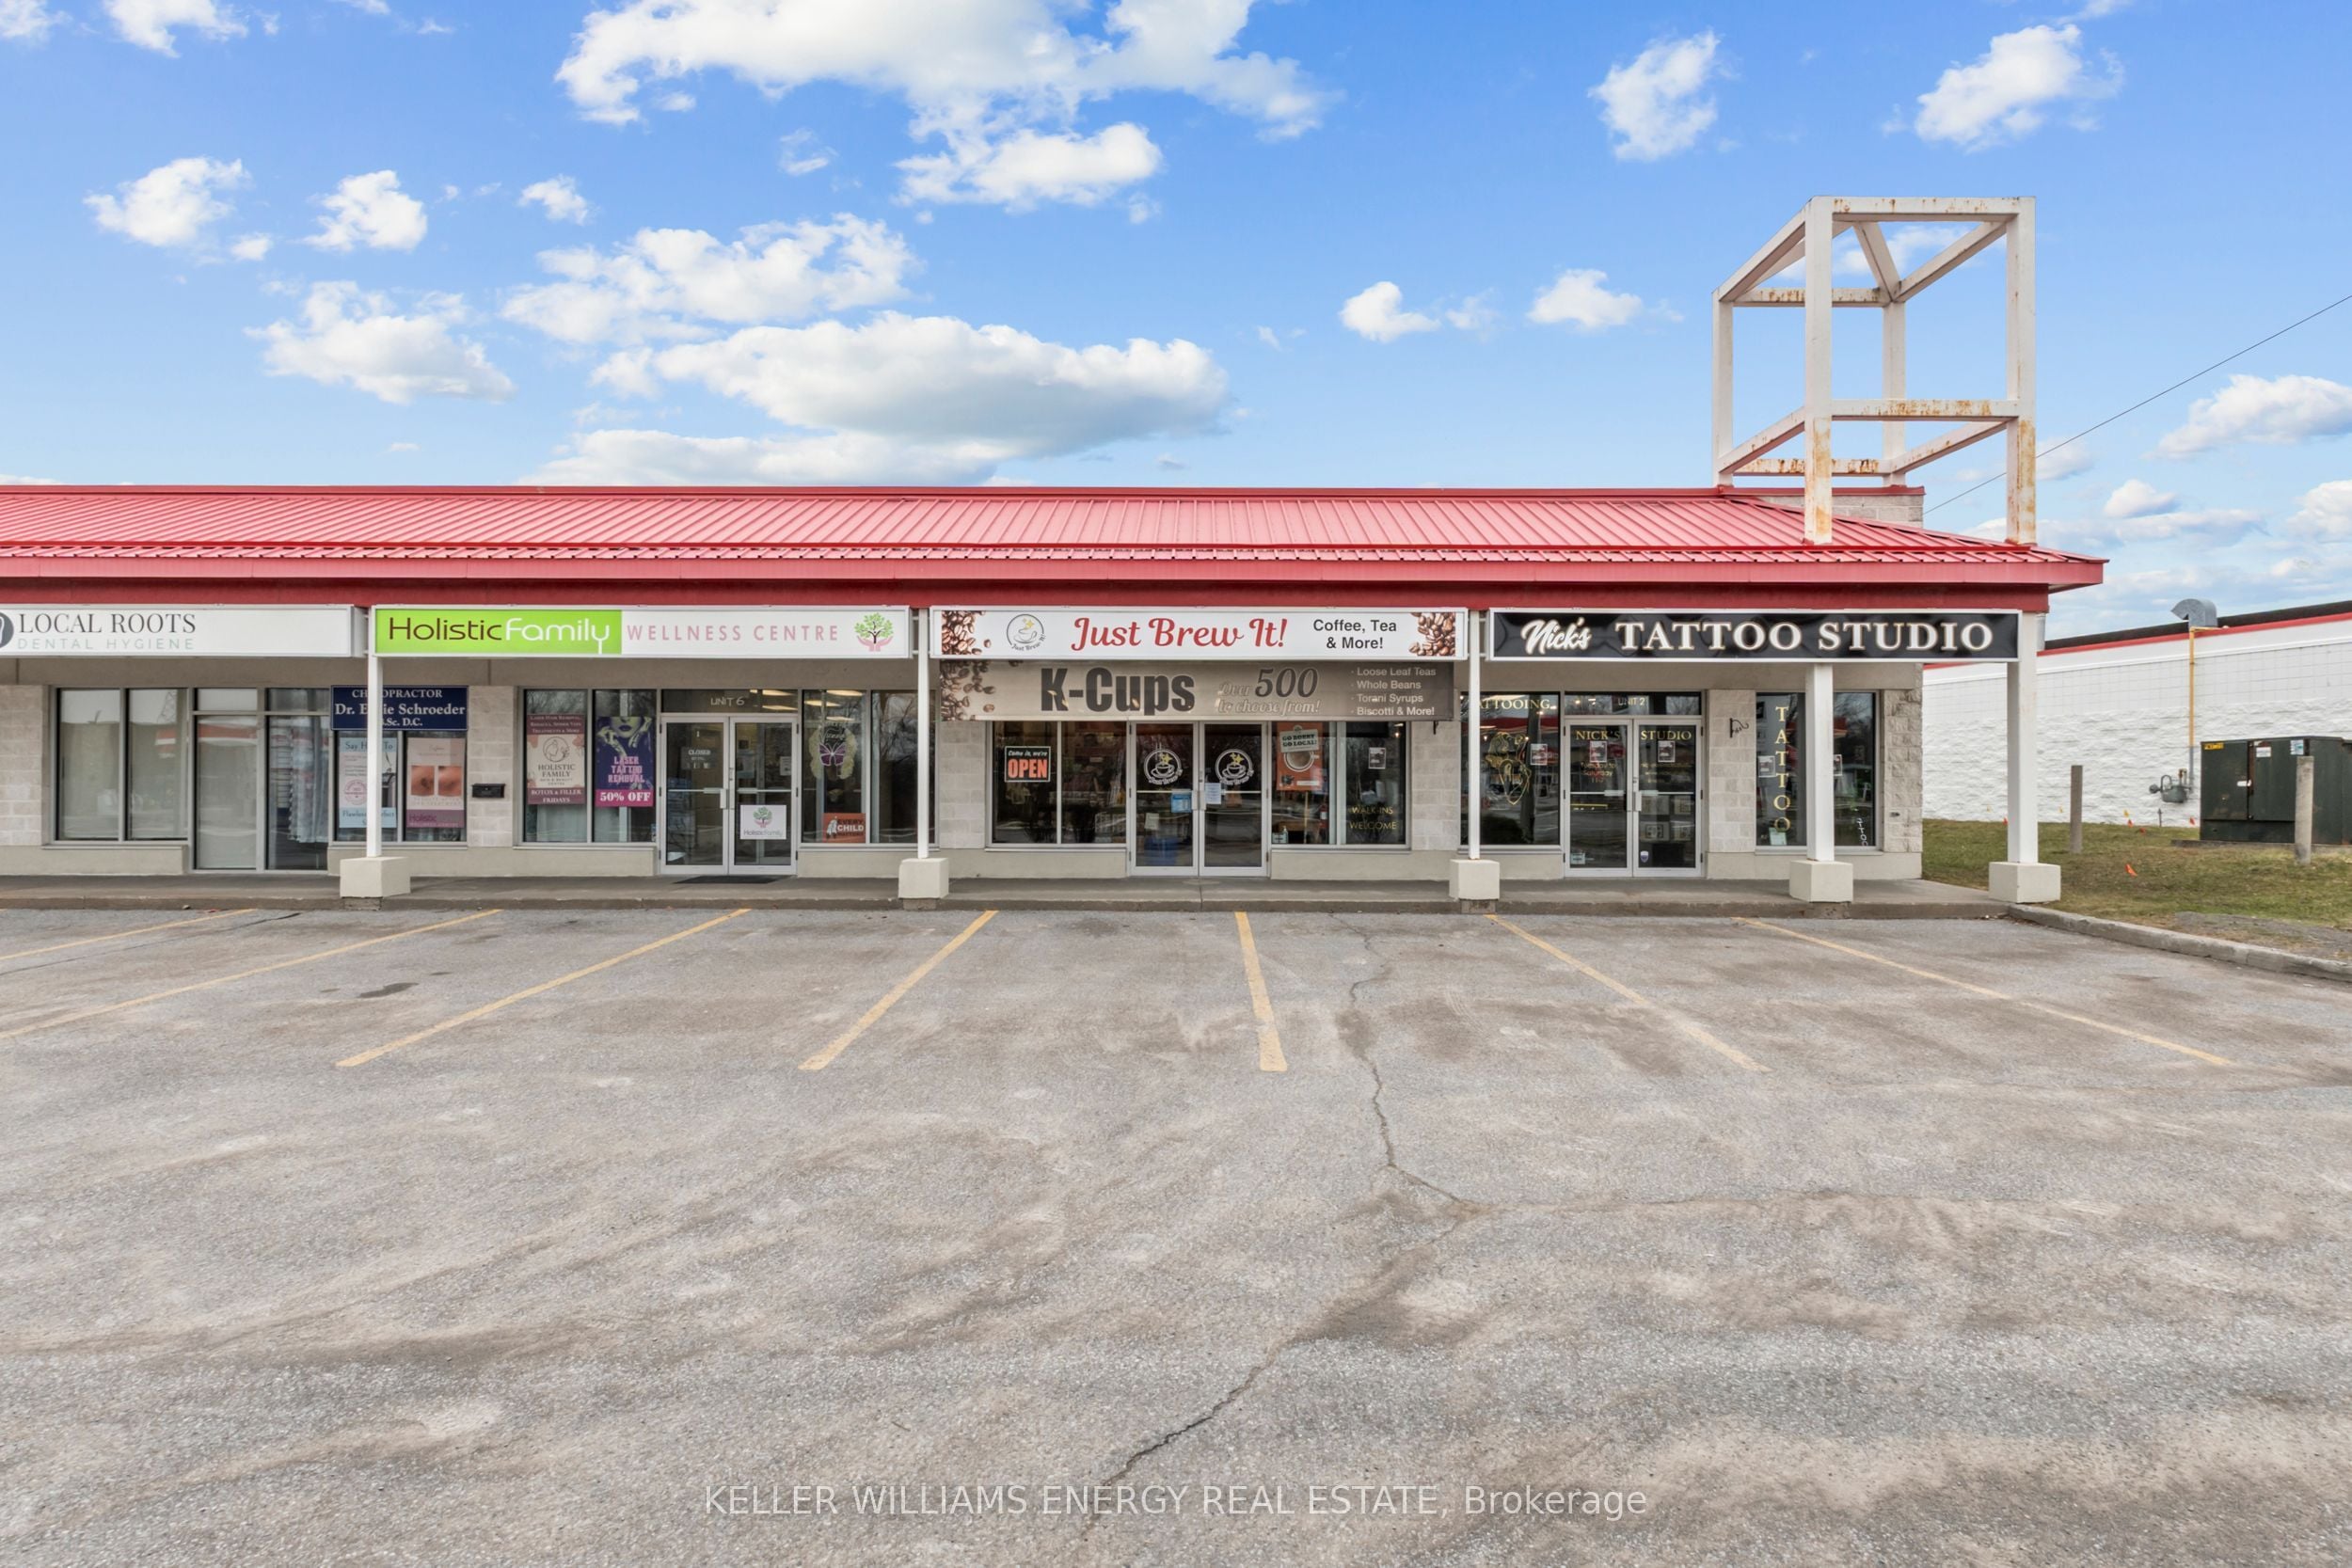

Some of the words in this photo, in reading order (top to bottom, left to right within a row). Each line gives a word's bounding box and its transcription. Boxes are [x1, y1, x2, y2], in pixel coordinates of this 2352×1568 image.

[19, 613, 103, 633] LOCAL
[110, 613, 196, 634] ROOTS
[1313, 619, 1366, 633] Coffee,
[1371, 619, 1397, 632] Tea
[627, 625, 741, 641] WELLNESS
[754, 625, 838, 641] CENTRE
[1071, 617, 1141, 651] Just
[1149, 617, 1244, 646] Brew
[1248, 617, 1288, 647] It!
[1520, 616, 1593, 655] Nick's
[1614, 621, 1803, 651] TATTOO
[1818, 621, 1994, 651] STUDIO
[18, 638, 94, 650] DENTAL
[106, 638, 195, 650] HYGIENE
[1326, 637, 1337, 649] &
[1342, 637, 1384, 649] More!
[1357, 667, 1388, 676] Loose
[1390, 667, 1411, 676] Leaf
[1414, 667, 1437, 676] Teas
[1254, 668, 1318, 697] 500
[1357, 680, 1388, 689] Whole
[1391, 680, 1422, 689] Beans
[352, 689, 443, 698] CHOPRACTOR
[1041, 666, 1196, 716] K-Cups
[710, 696, 735, 706] UNIT
[736, 696, 745, 705] 6
[1357, 693, 1387, 703] Torani
[1389, 693, 1423, 705] Syrups
[1479, 699, 1550, 710] TTOOING
[1639, 697, 1645, 705] 2
[335, 703, 356, 715] Dr.
[398, 703, 466, 715] Schroeder
[1357, 706, 1394, 716] Biscotti
[1396, 706, 1404, 716] &
[1406, 706, 1435, 716] More!
[403, 717, 423, 727] D.C.
[1576, 730, 1620, 740] NICK'S
[1640, 730, 1692, 740] STUDIO
[1008, 758, 1048, 779] OPEN
[1772, 705, 1791, 832] TATTOO
[608, 774, 645, 783] REMOVAL
[600, 792, 625, 801] 50%
[628, 792, 651, 801] OFF
